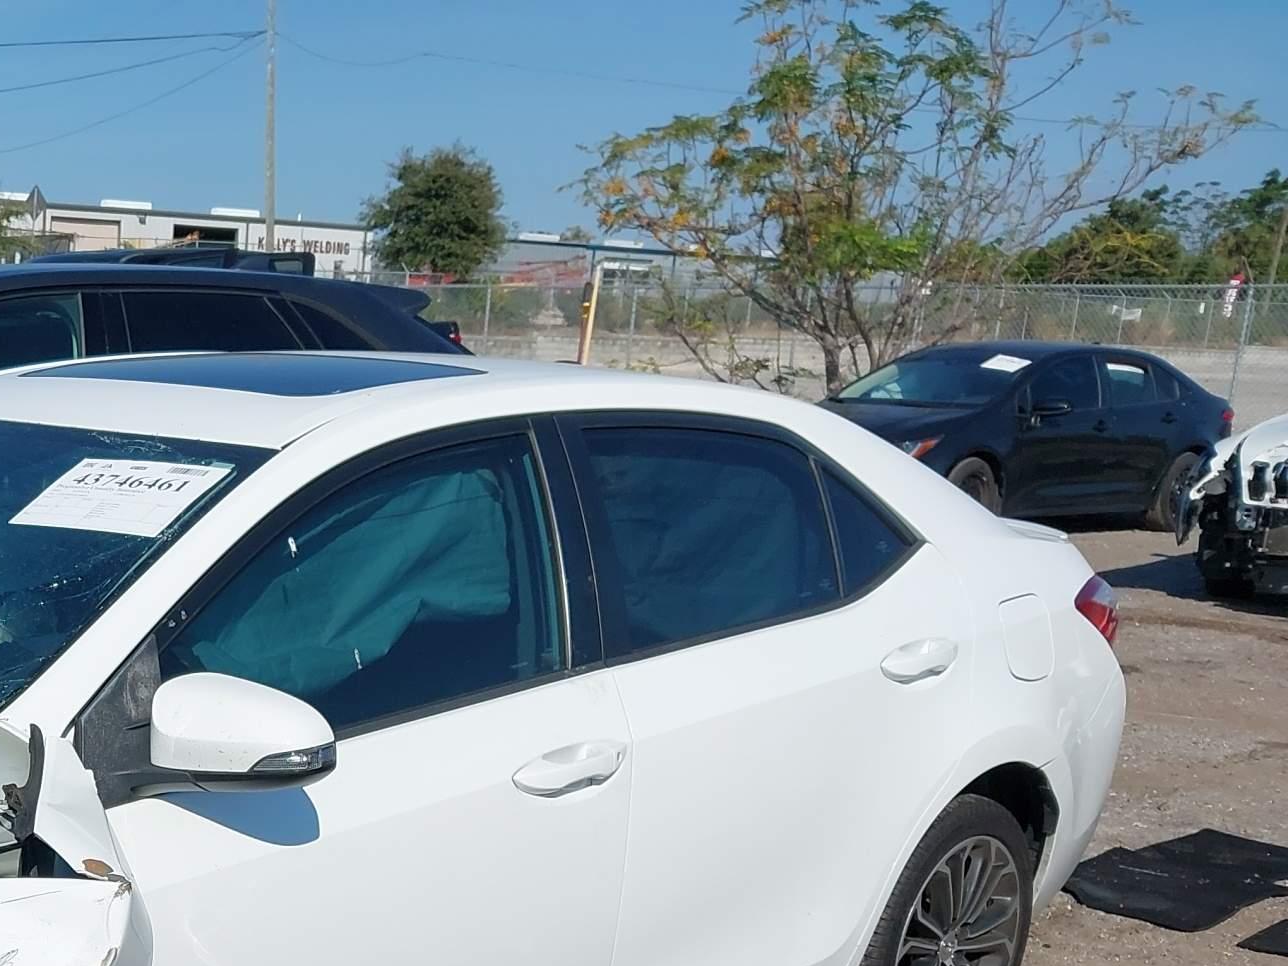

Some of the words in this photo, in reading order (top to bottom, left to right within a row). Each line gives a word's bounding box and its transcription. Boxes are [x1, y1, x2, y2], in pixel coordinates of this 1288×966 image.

[257, 236, 296, 251] KLY'S
[303, 239, 350, 255] WELDING
[73, 473, 190, 491] 43746461
